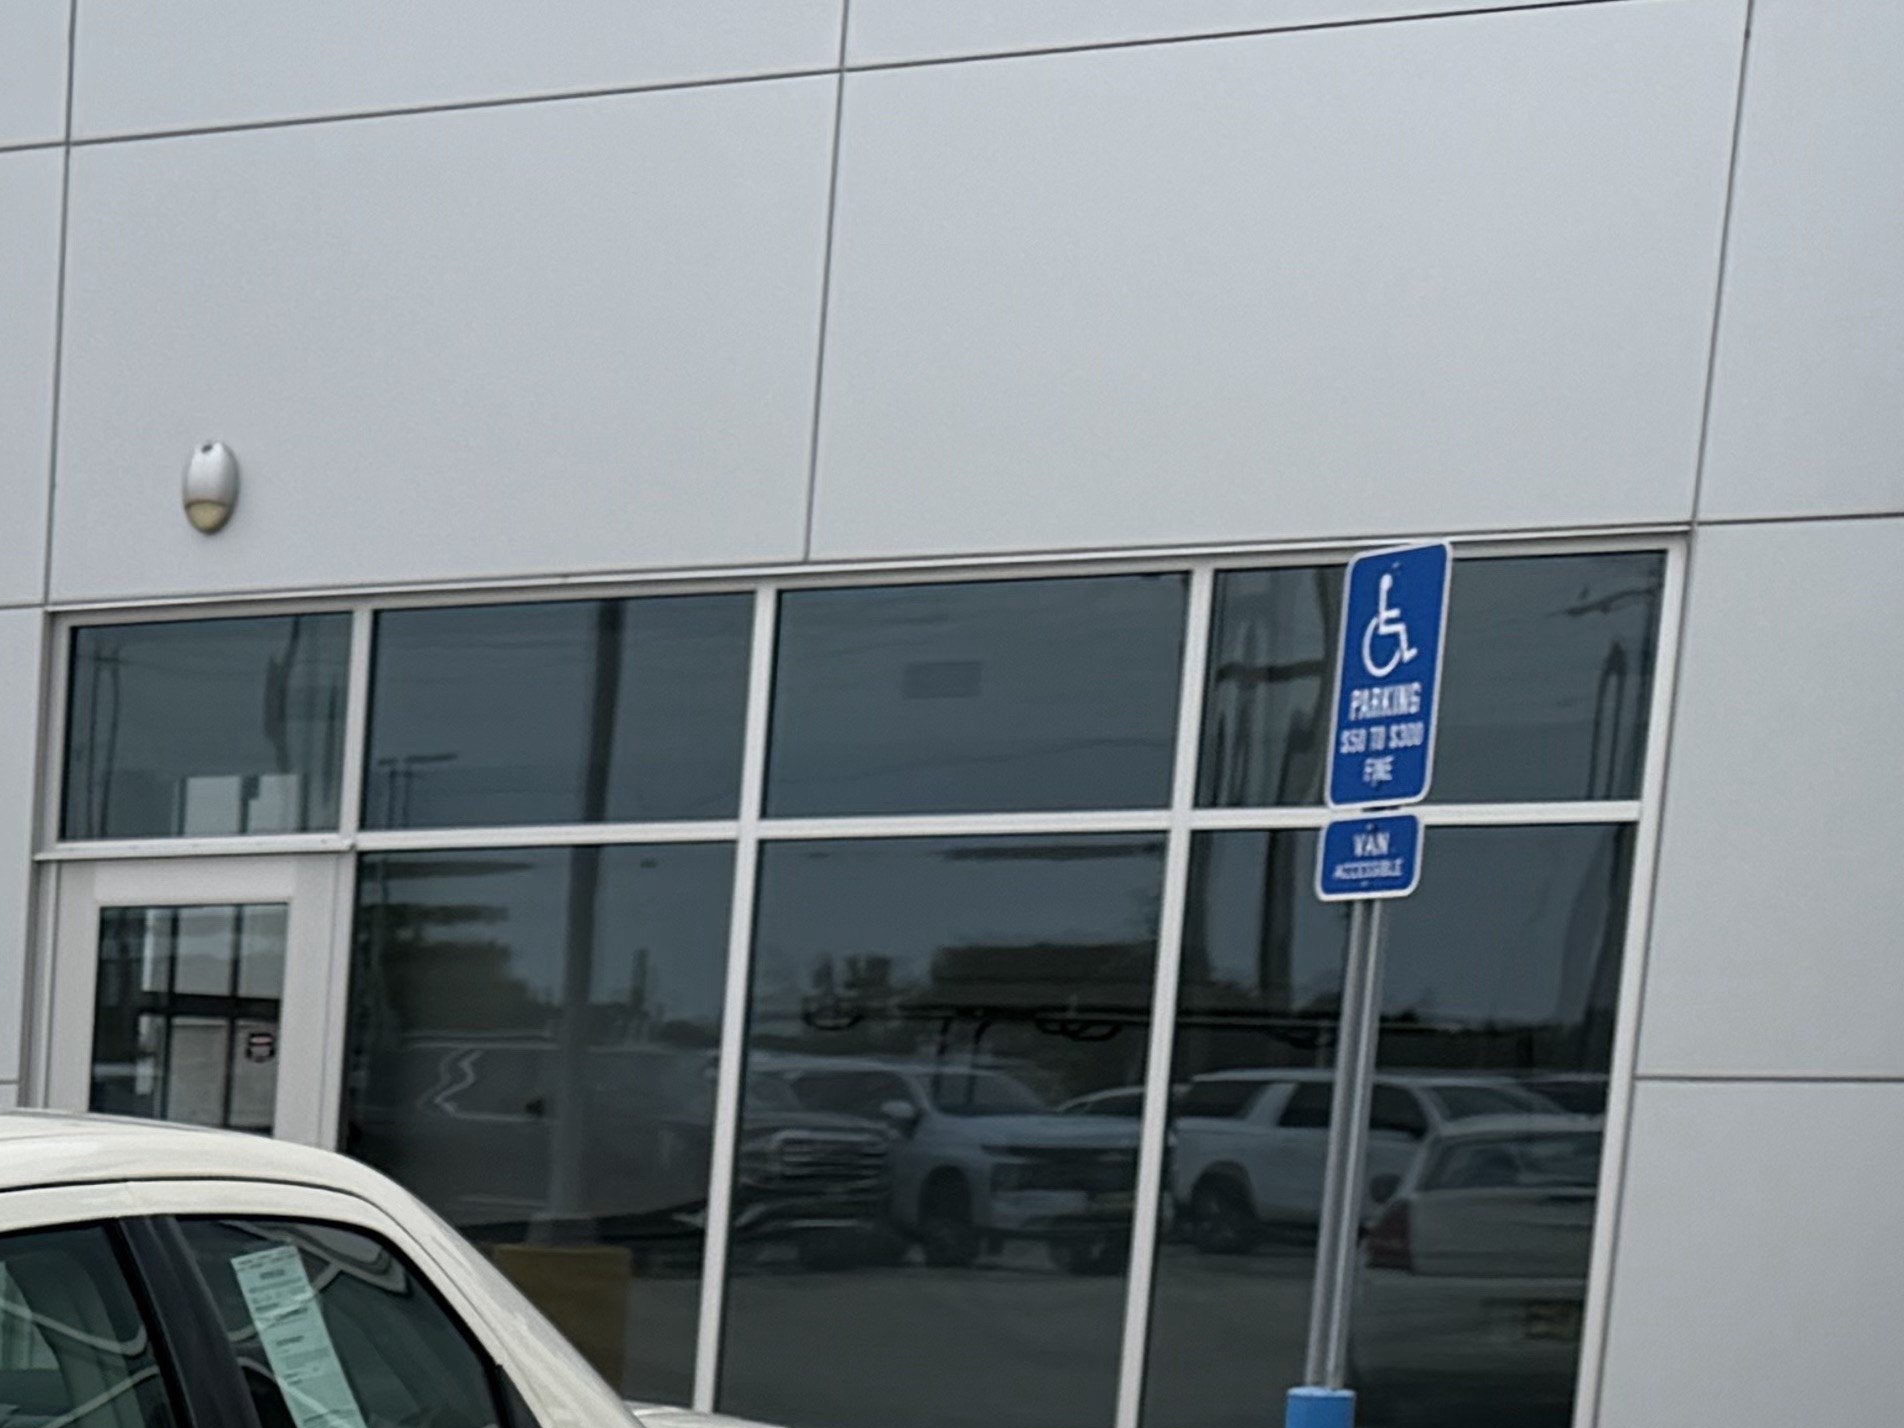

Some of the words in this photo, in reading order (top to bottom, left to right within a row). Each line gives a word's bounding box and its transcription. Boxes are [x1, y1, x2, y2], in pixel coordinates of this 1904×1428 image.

[1350, 682, 1421, 721] PARKING
[1369, 724, 1386, 752] TO
[1363, 756, 1394, 783] FINE
[1354, 832, 1390, 857] VAN
[1334, 859, 1403, 880] ACCESSIBLE
